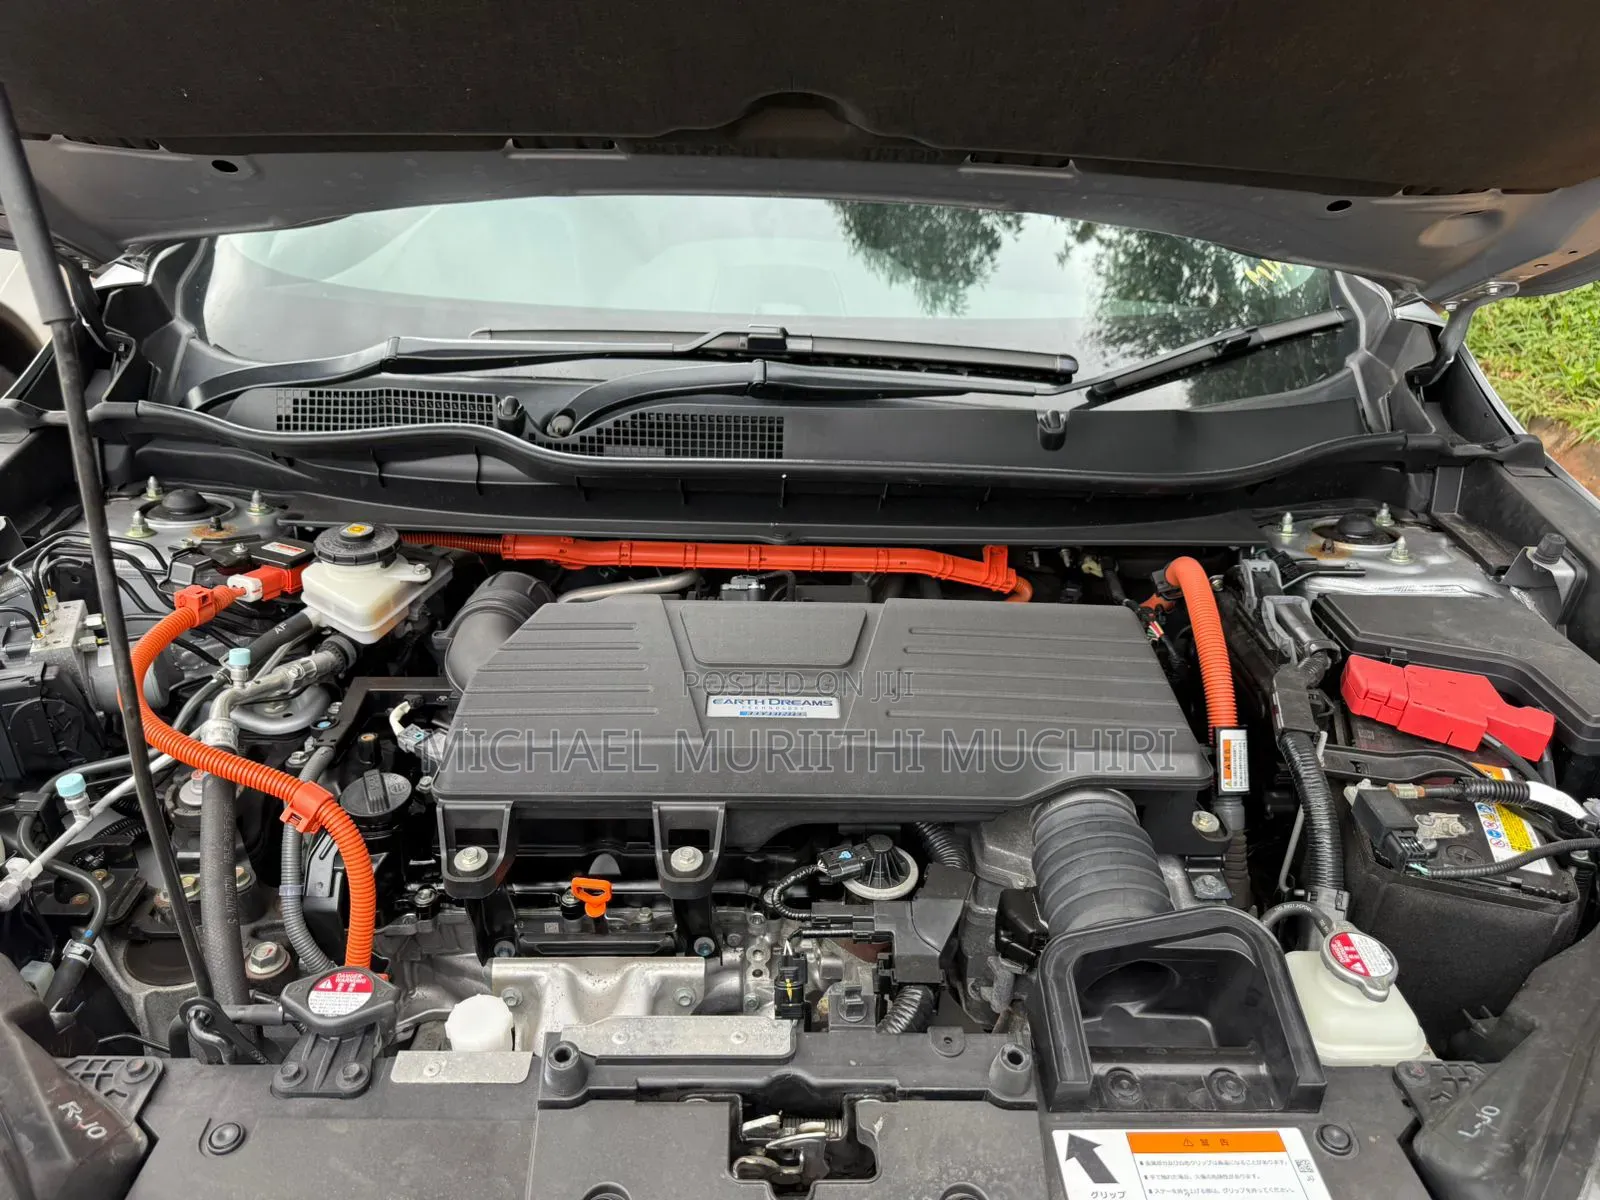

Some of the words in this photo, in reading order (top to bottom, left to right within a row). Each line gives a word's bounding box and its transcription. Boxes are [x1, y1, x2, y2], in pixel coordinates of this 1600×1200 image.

[712, 698, 766, 706] EARTH
[768, 698, 833, 706] DREAMS
[1091, 1190, 1126, 1199] グリップ
